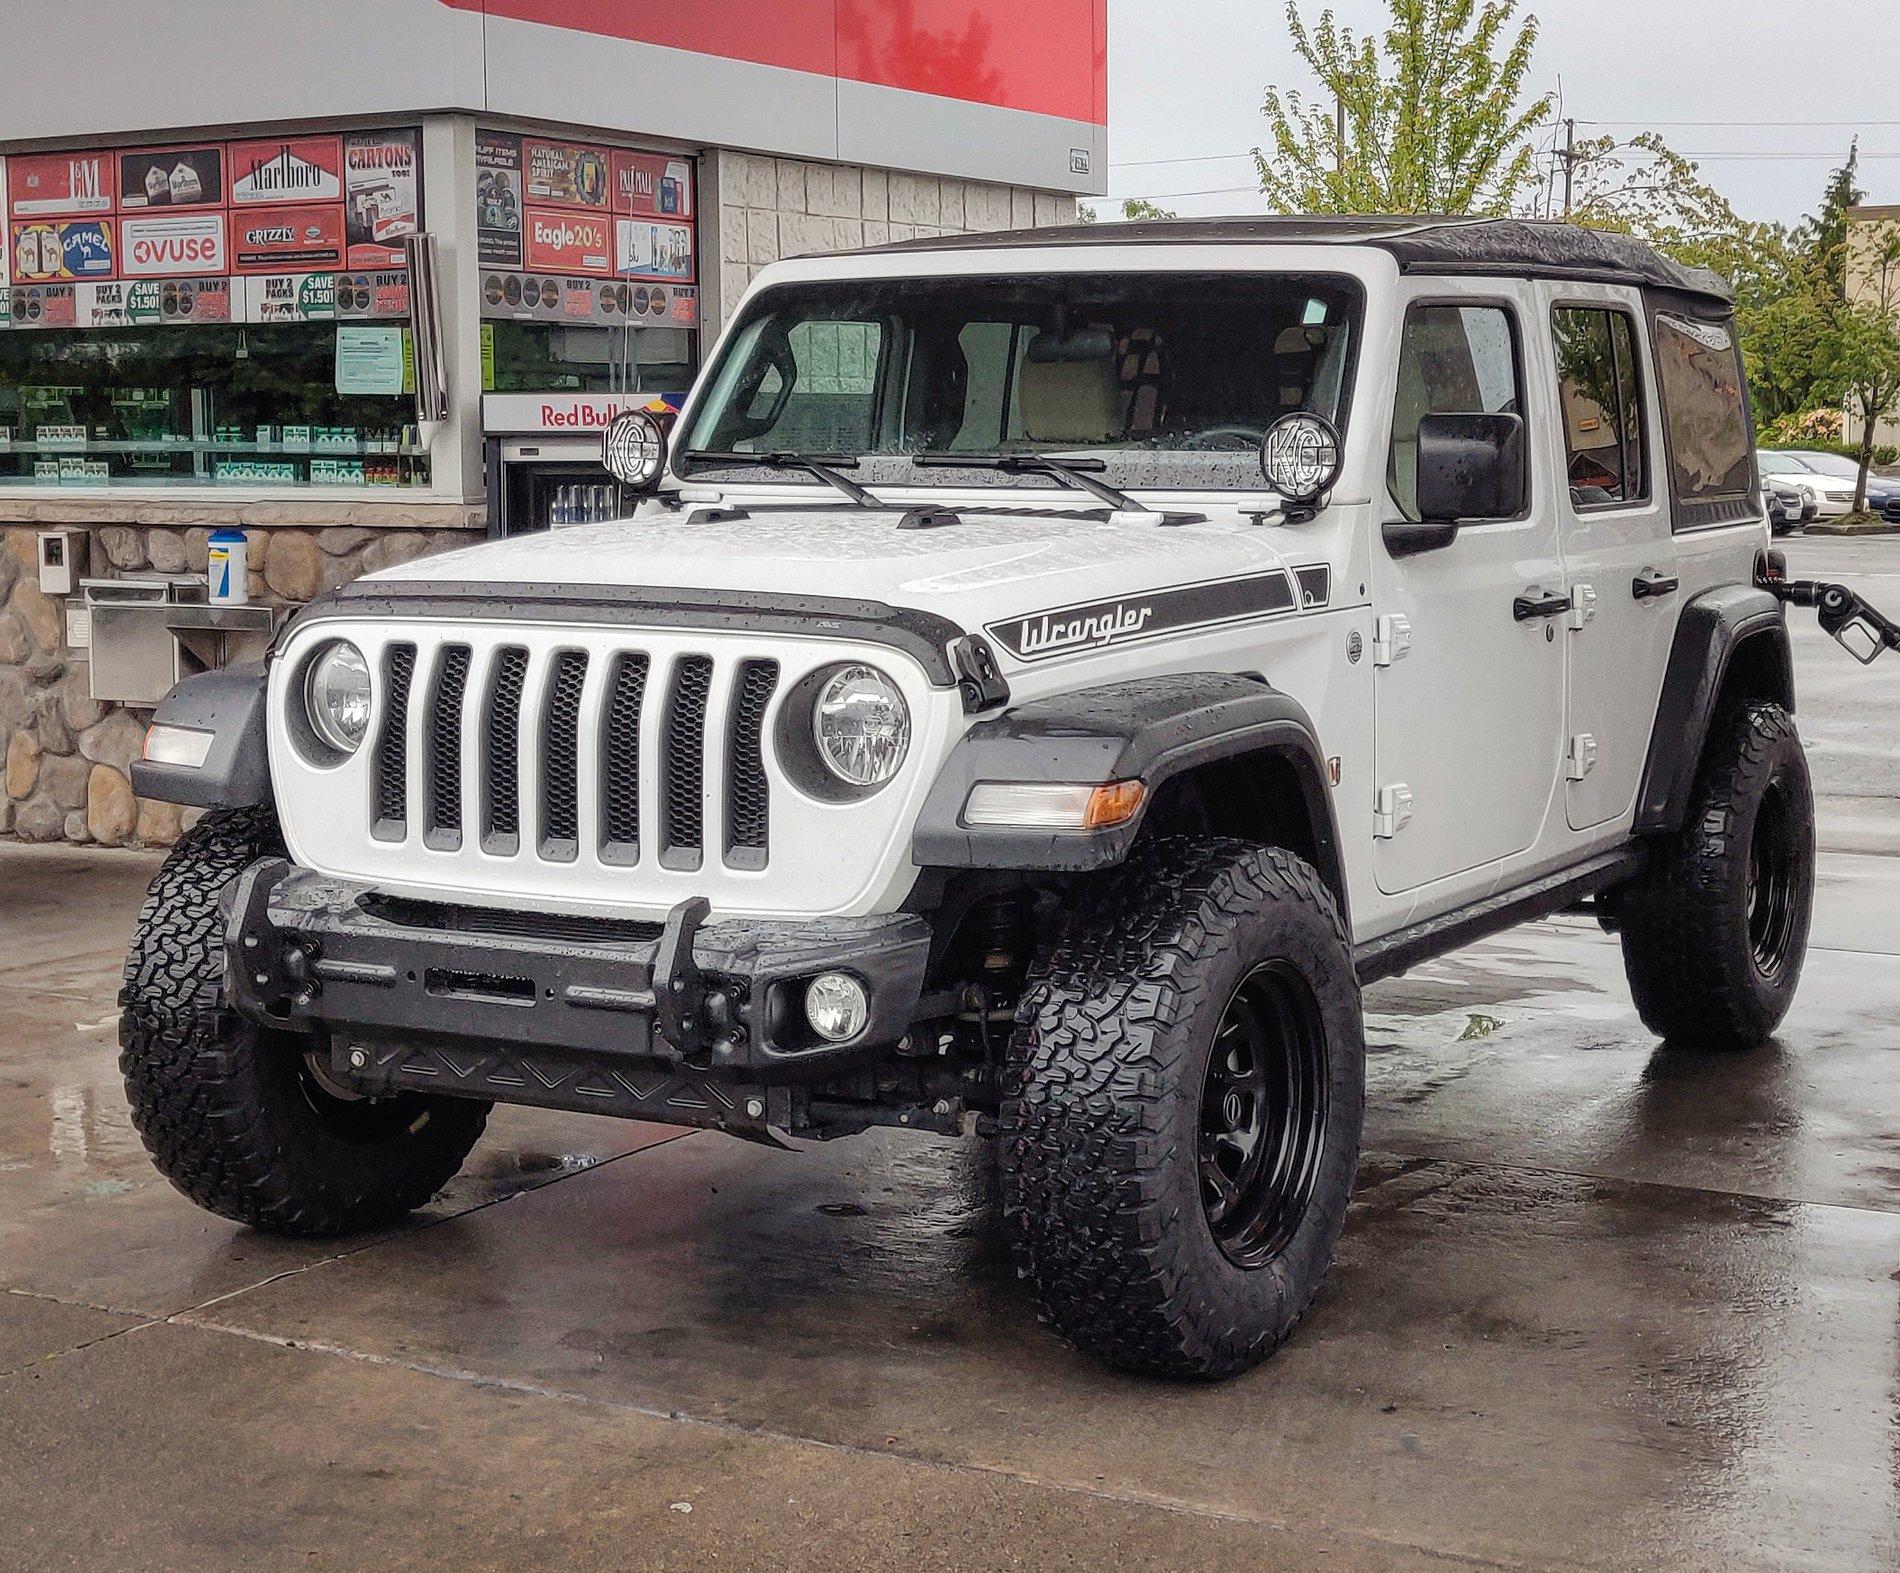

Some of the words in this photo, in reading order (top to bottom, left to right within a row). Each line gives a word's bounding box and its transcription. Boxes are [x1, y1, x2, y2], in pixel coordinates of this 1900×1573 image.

[348, 144, 412, 169] CARTONS
[251, 145, 320, 191] Marlboro
[63, 231, 109, 252] CAMEL
[245, 227, 296, 247] GRIZZLY
[135, 282, 160, 296] SAVE
[199, 281, 219, 292] BUY
[266, 279, 284, 289] BUY
[287, 278, 293, 287] 2
[307, 275, 334, 290] SAVE
[376, 274, 398, 287] BUY
[566, 279, 583, 290] BUY
[585, 281, 591, 290] 2
[95, 285, 112, 295] BUY
[265, 287, 294, 299] PACKS
[541, 403, 579, 427] Red
[582, 403, 618, 427] Bull
[603, 418, 645, 480] KC
[1268, 422, 1324, 490] KC
[1020, 604, 1152, 655] Wrangler
